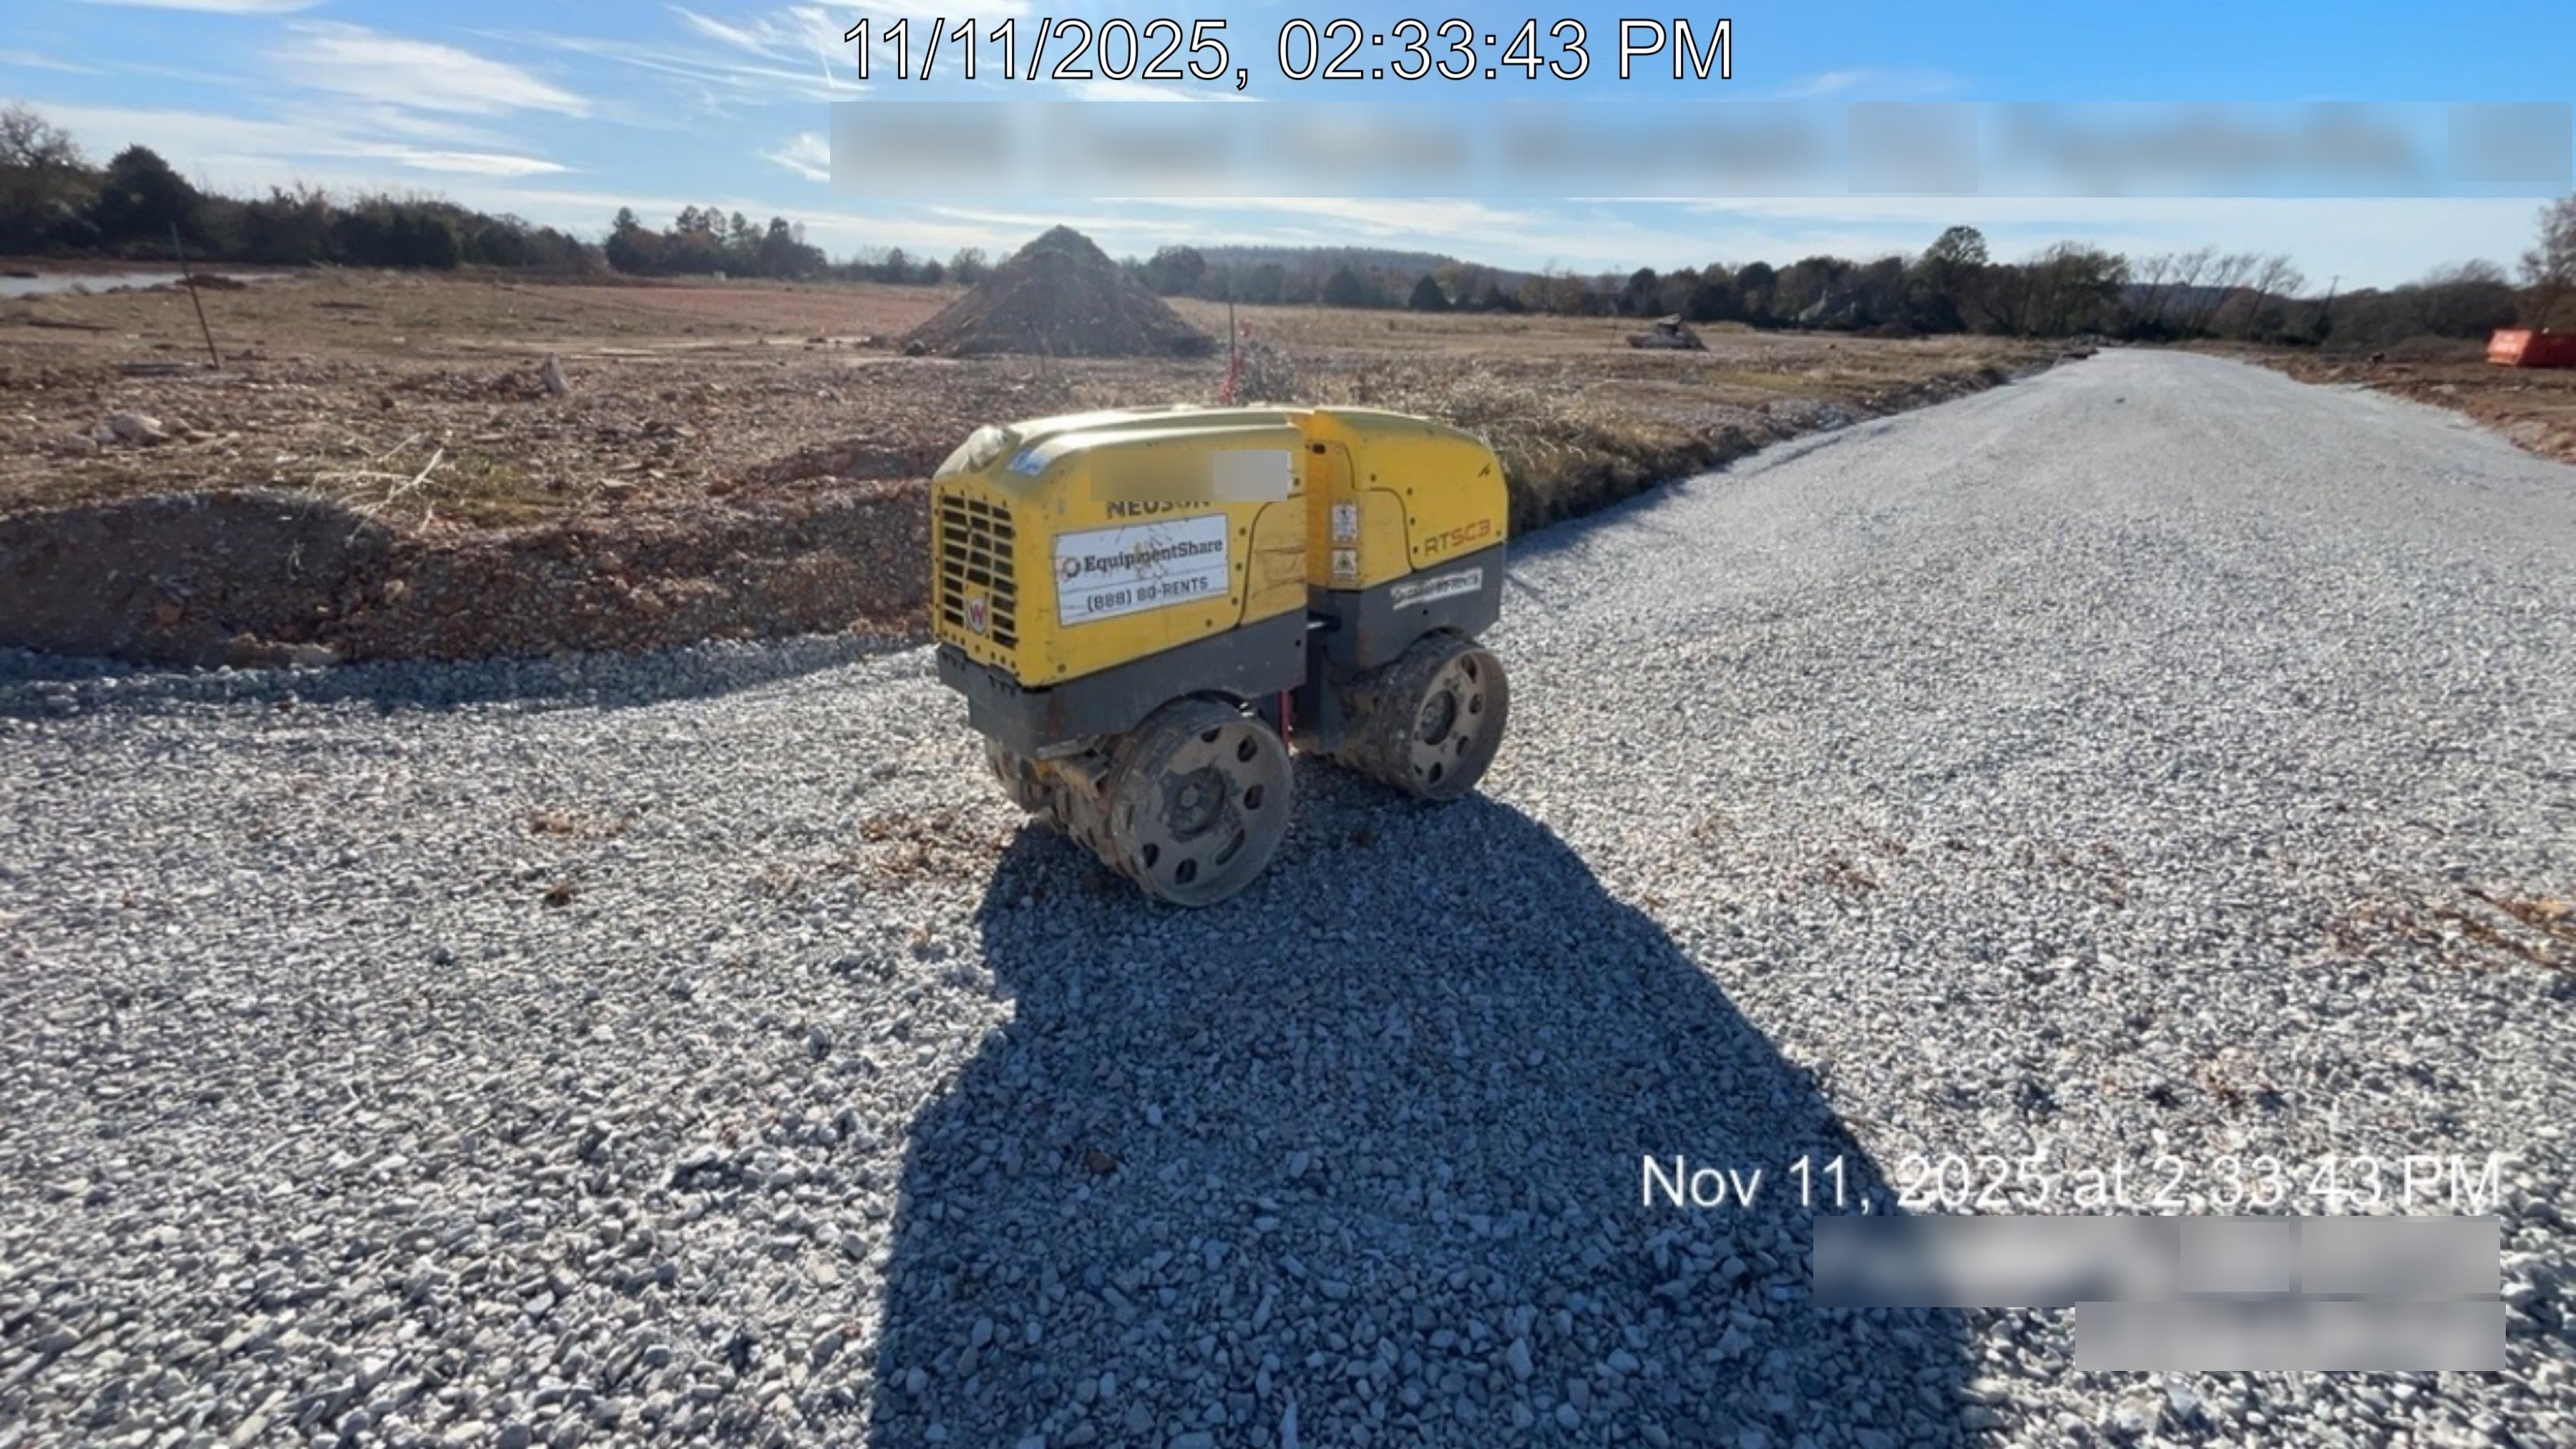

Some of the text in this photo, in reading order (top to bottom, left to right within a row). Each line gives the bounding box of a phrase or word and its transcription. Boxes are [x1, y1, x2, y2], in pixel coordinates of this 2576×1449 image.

[1107, 501, 1211, 519] NEUS
[1083, 539, 1223, 573] EquipmentShare
[1087, 590, 1132, 613] (888)
